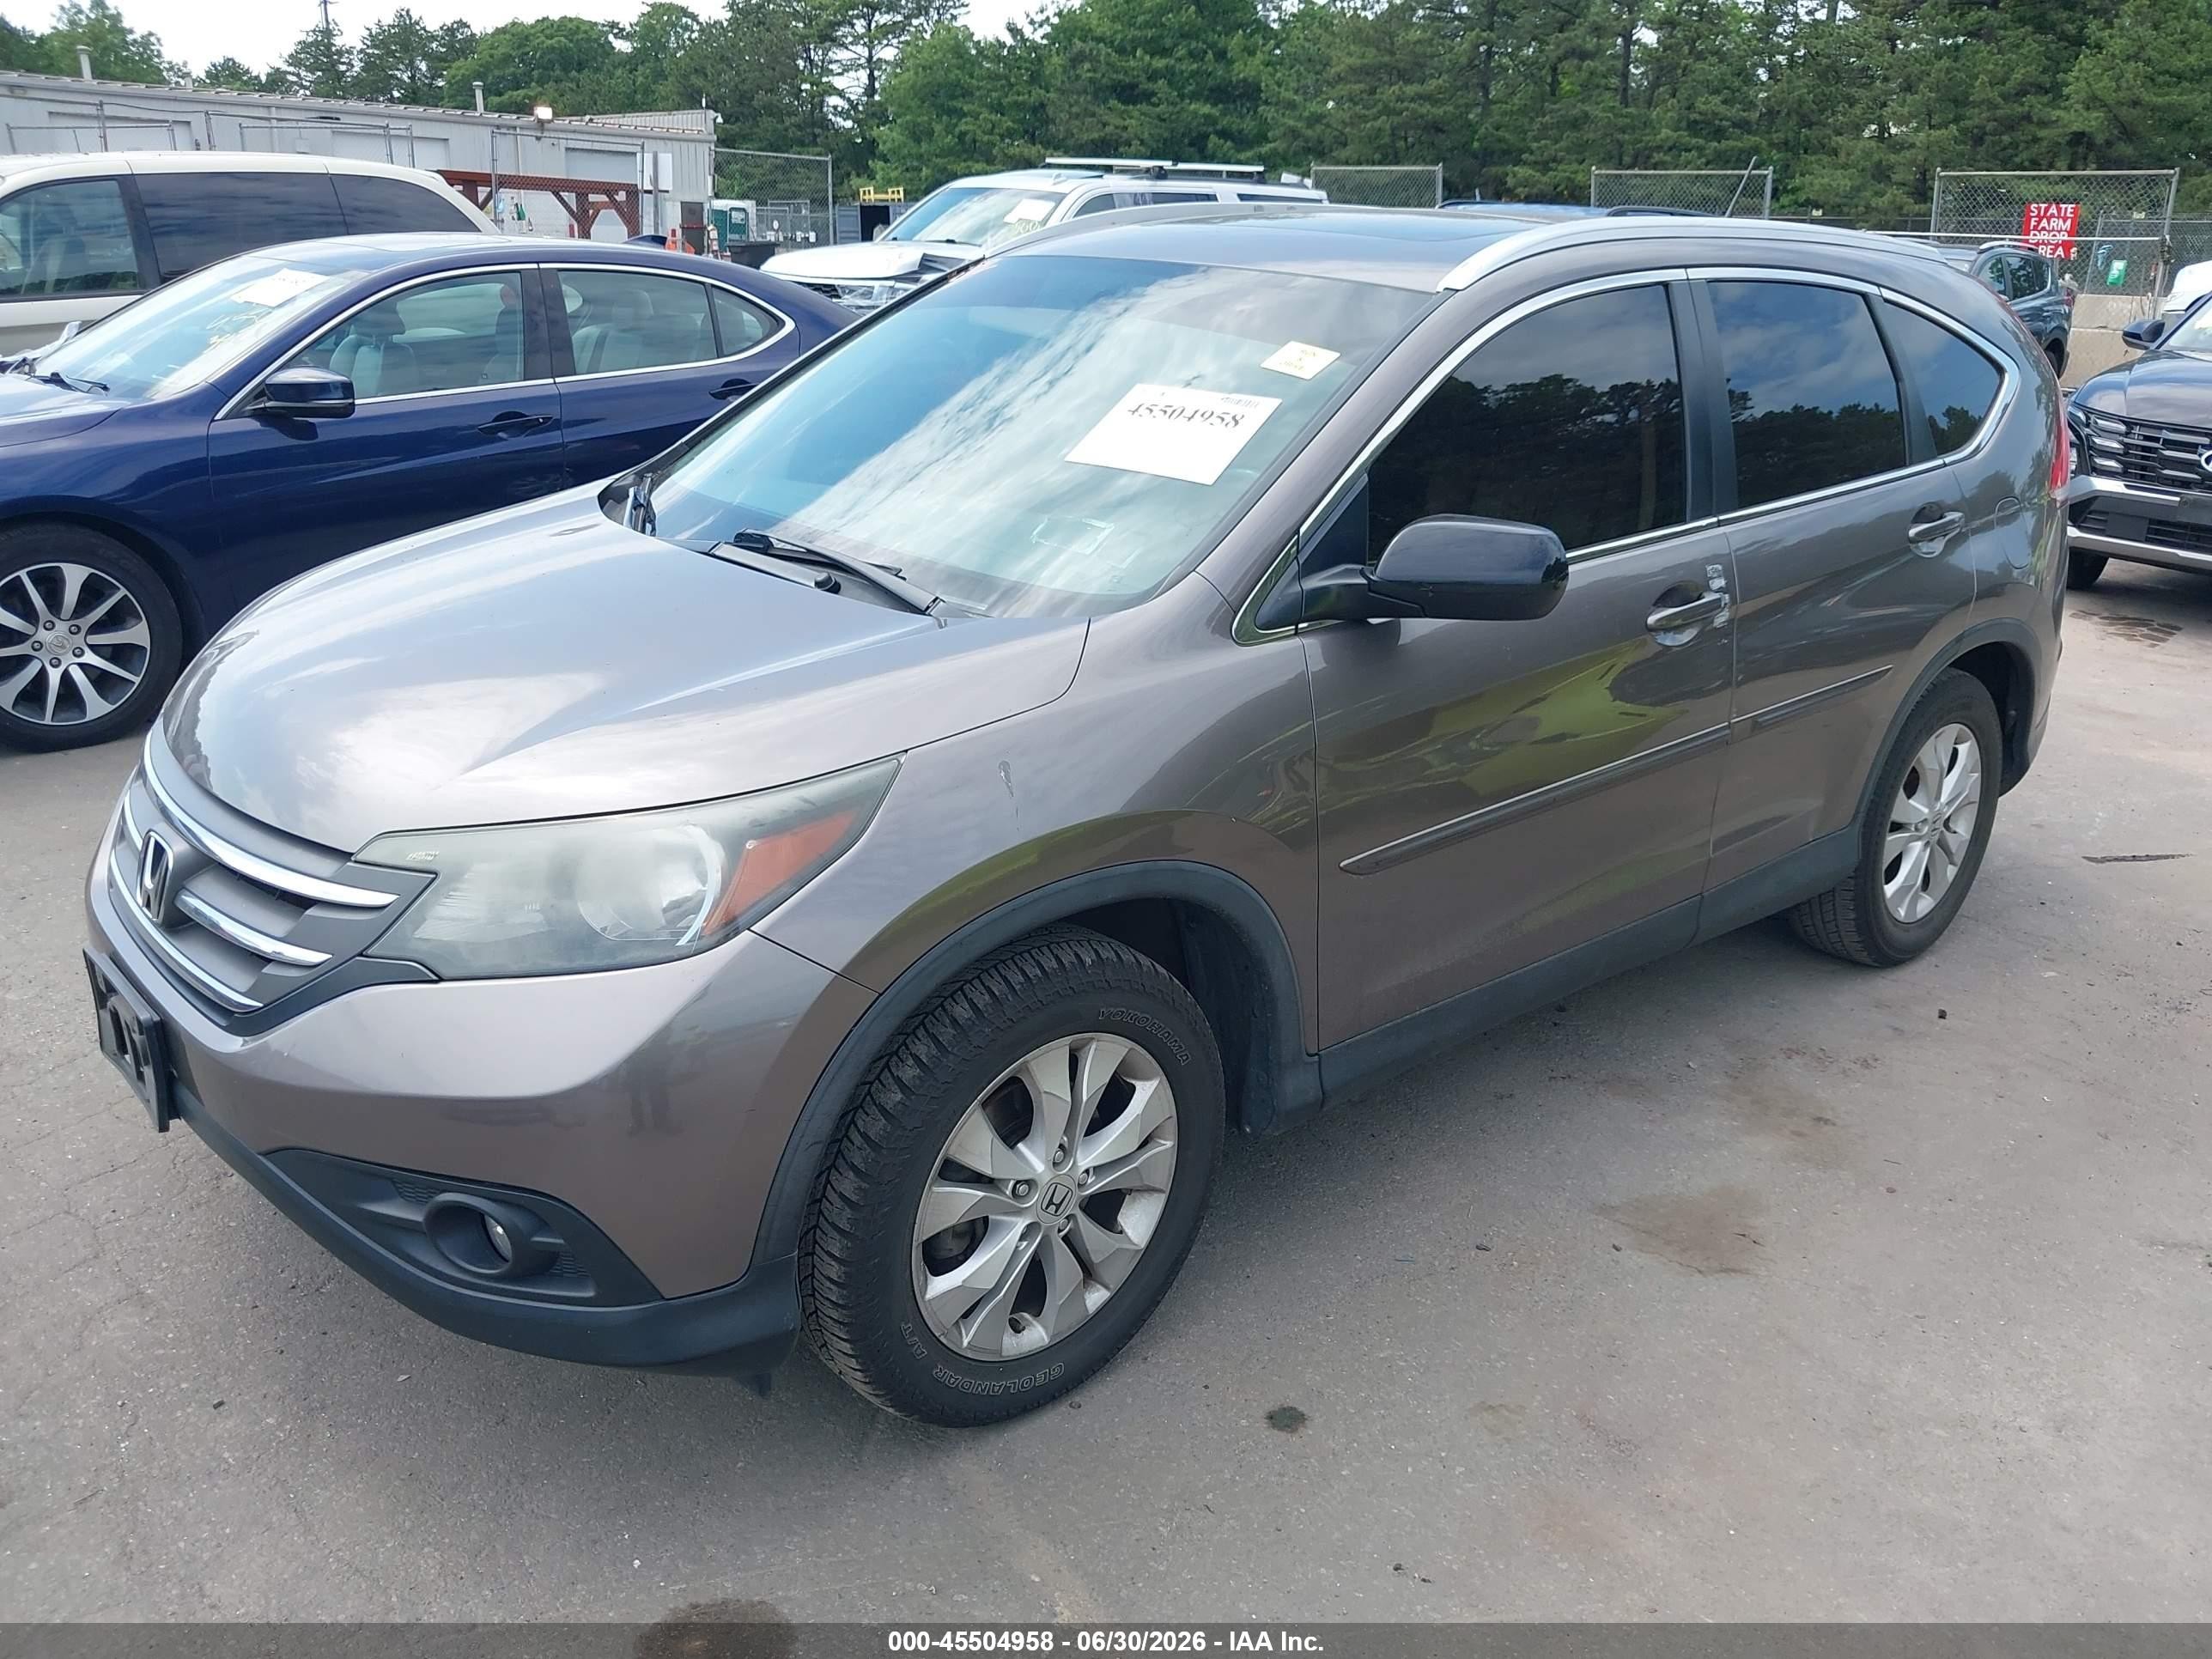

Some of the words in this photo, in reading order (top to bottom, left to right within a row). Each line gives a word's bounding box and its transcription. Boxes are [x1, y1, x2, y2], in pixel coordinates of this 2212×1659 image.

[2029, 204, 2076, 217] STATE
[2029, 217, 2072, 231] FARM
[2028, 230, 2069, 244] DROP
[2038, 245, 2065, 258] REA
[1127, 402, 1245, 428] 45504958
[1099, 1008, 1192, 1066] YOKOHAMA
[902, 1323, 927, 1359] A/T
[933, 1362, 1065, 1395] GEOLANDAR
